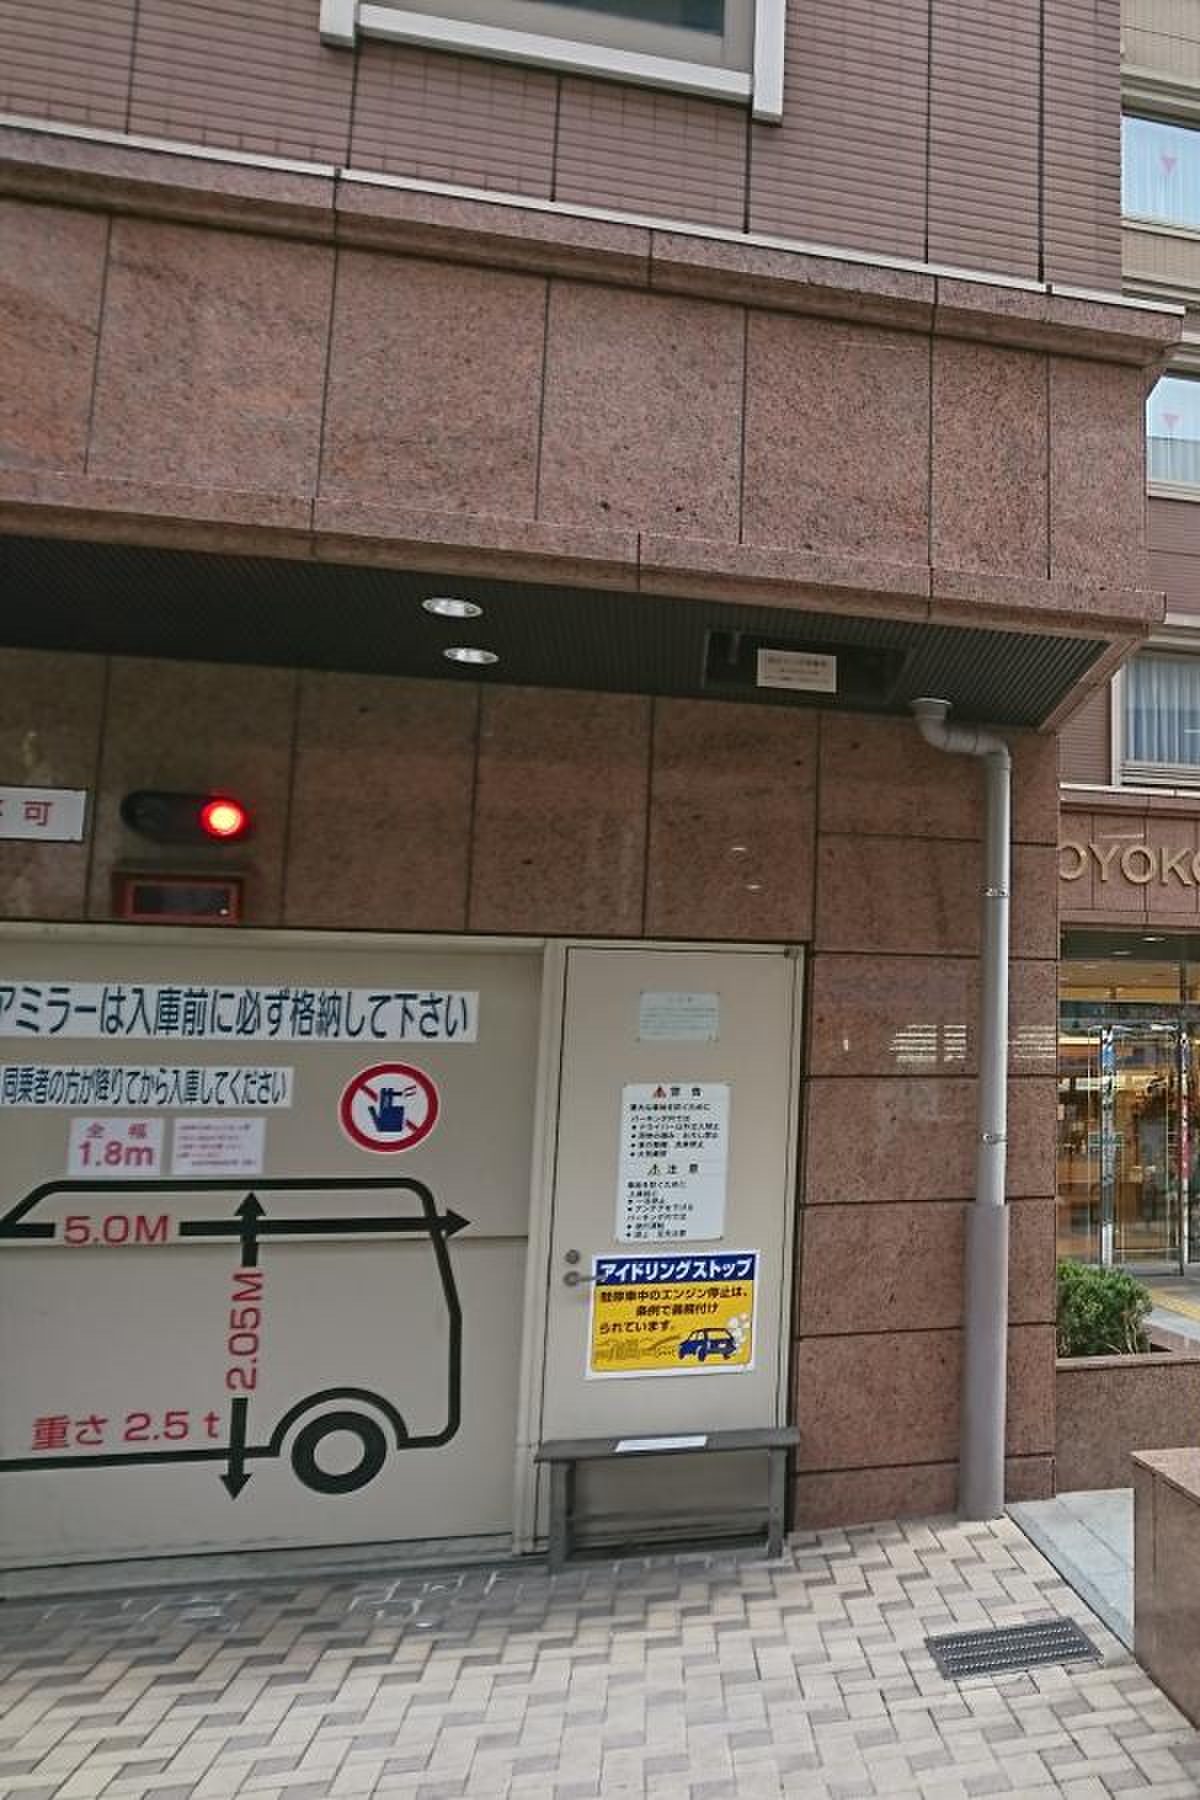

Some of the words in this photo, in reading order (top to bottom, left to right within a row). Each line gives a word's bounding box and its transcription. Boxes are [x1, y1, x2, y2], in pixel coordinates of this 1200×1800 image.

[79, 1140, 153, 1167] 1.8m
[64, 1214, 169, 1245] 5.0M
[601, 1257, 753, 1282] アイドリングストップ
[226, 1272, 264, 1391] 2.05M
[32, 1414, 108, 1451] 重さ
